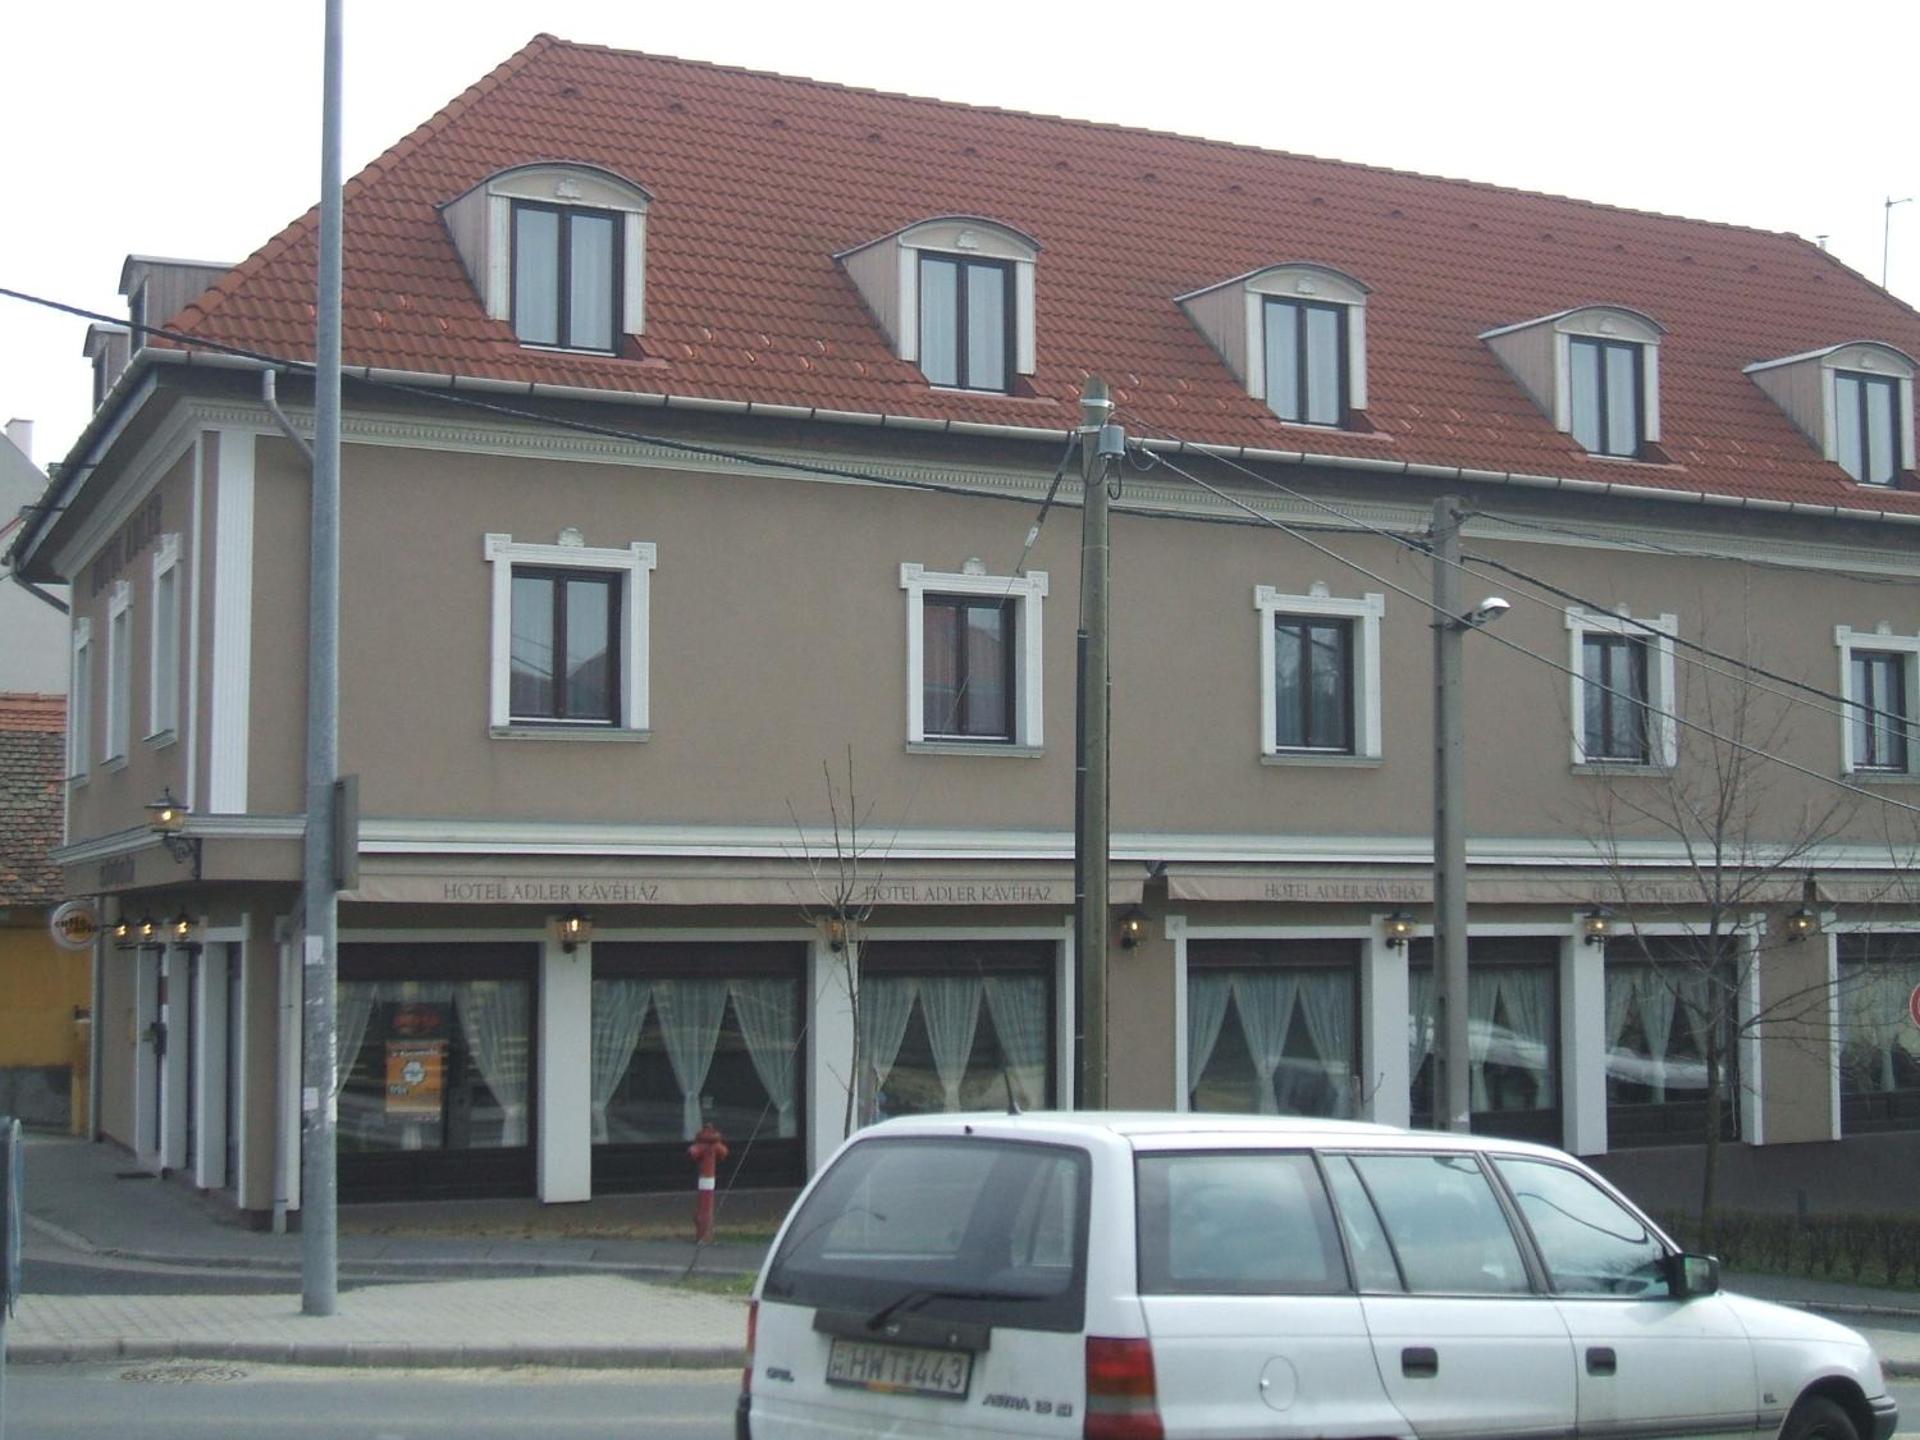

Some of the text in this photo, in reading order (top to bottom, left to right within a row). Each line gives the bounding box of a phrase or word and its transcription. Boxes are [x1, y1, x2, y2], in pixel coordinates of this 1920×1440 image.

[444, 881, 659, 900] HOTEL ADLER KÁVÉHÁZ
[865, 886, 918, 901] HOTEL
[926, 887, 975, 902] ADLER
[1265, 882, 1310, 898] HOTEL
[1318, 884, 1361, 900] ADLER
